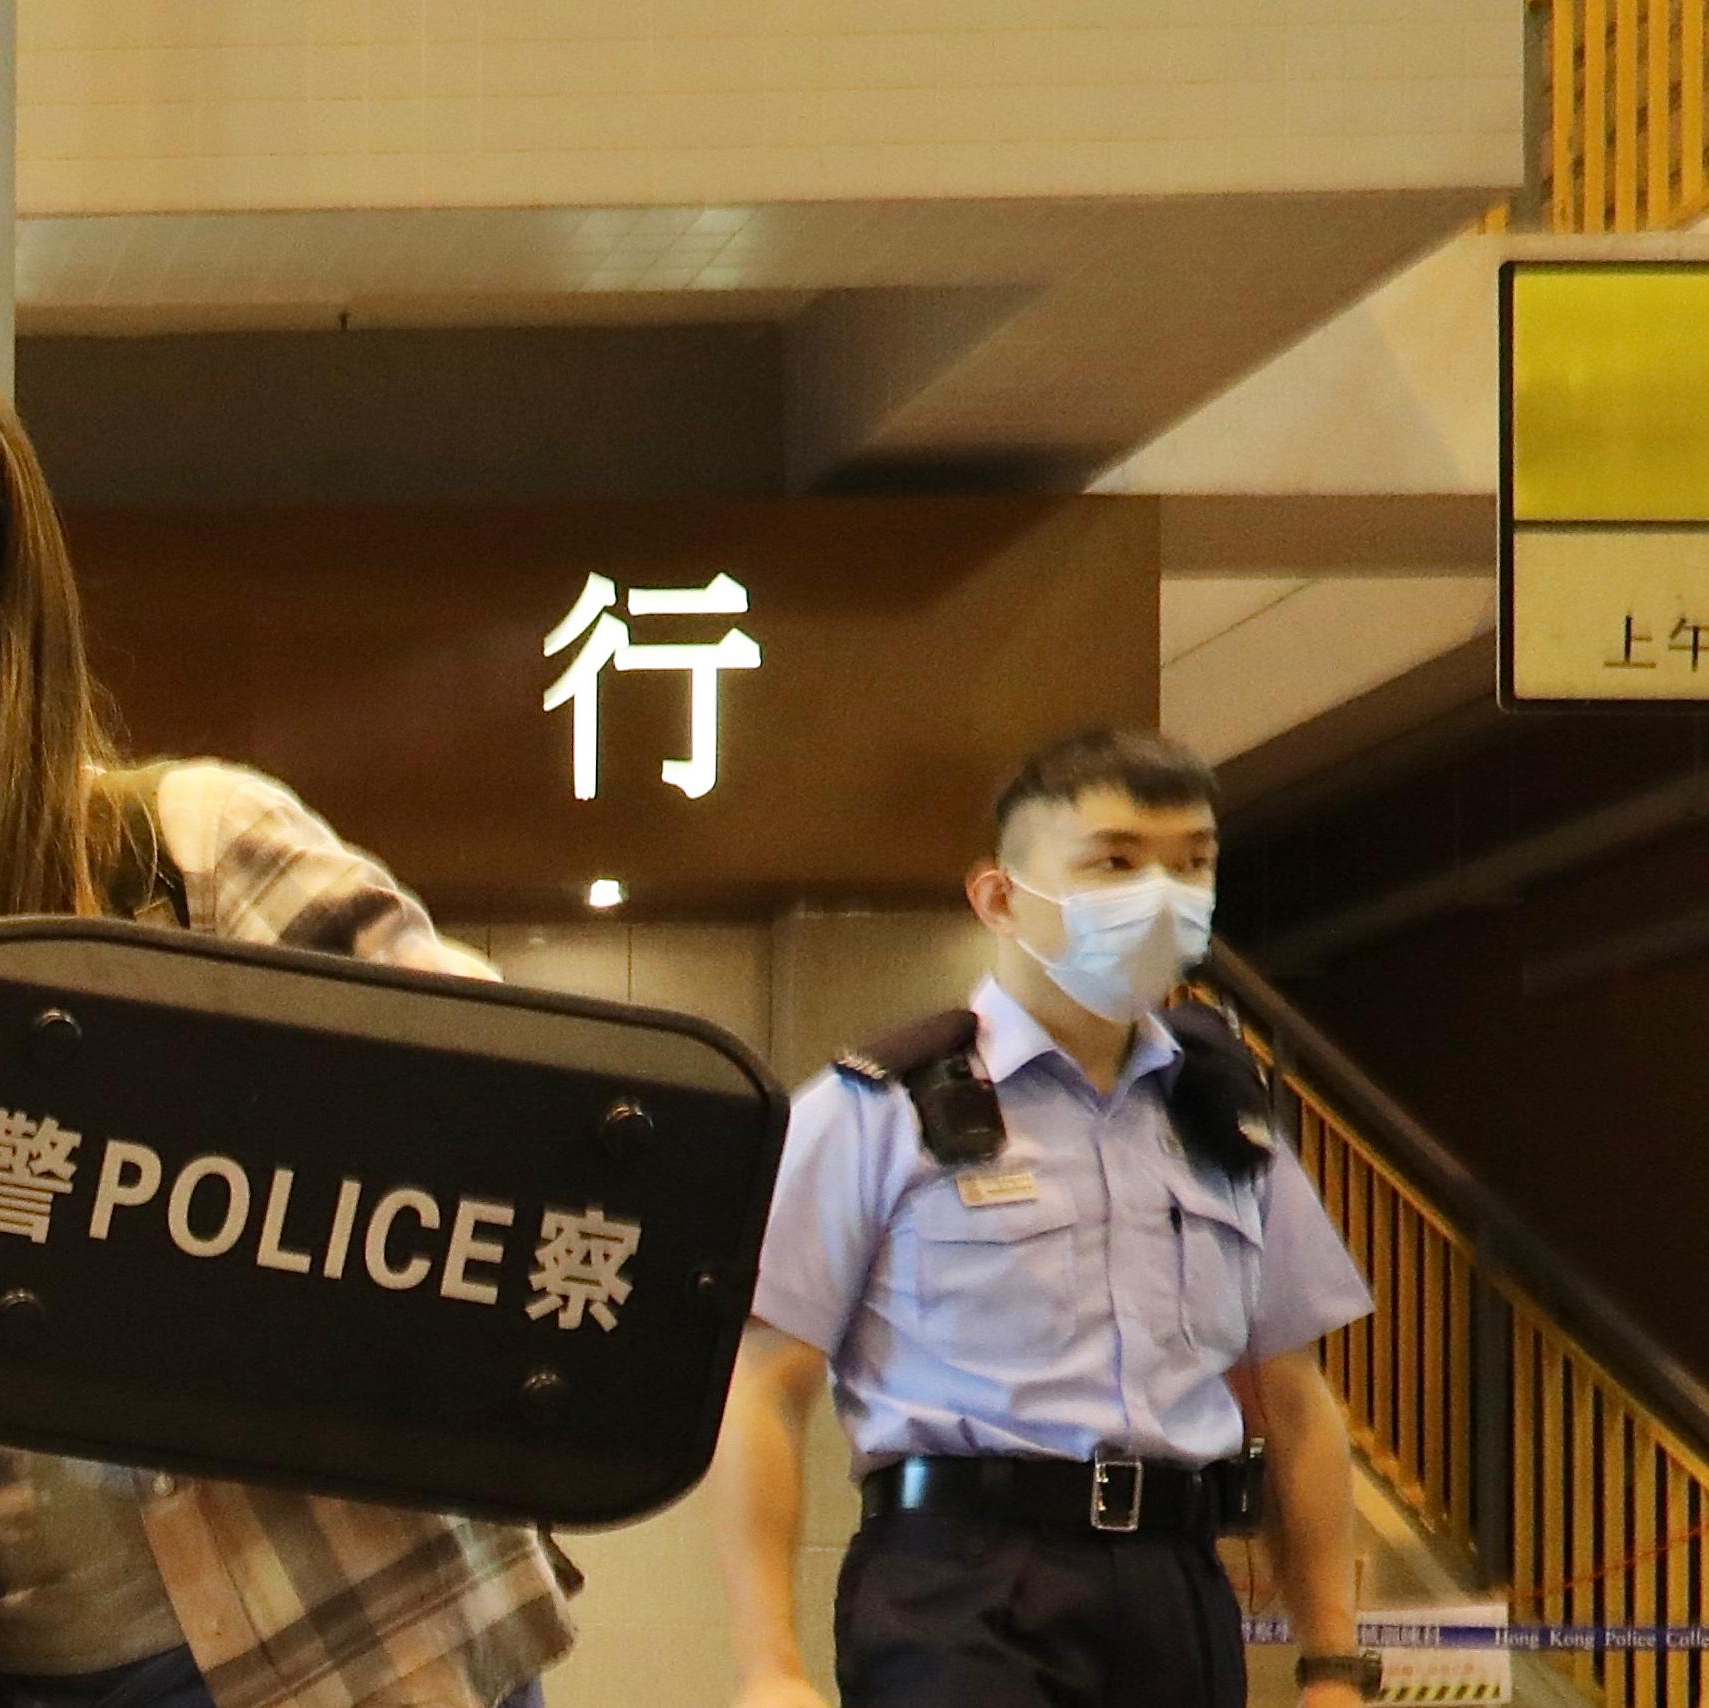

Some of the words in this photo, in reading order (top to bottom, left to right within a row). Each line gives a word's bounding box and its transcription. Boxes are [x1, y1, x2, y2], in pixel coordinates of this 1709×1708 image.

[543, 572, 761, 801] 行
[89, 1136, 515, 1306] POLICE
[1494, 1627, 1539, 1650] Hong
[1549, 1629, 1595, 1650] Kong
[1604, 1627, 1656, 1647] Police
